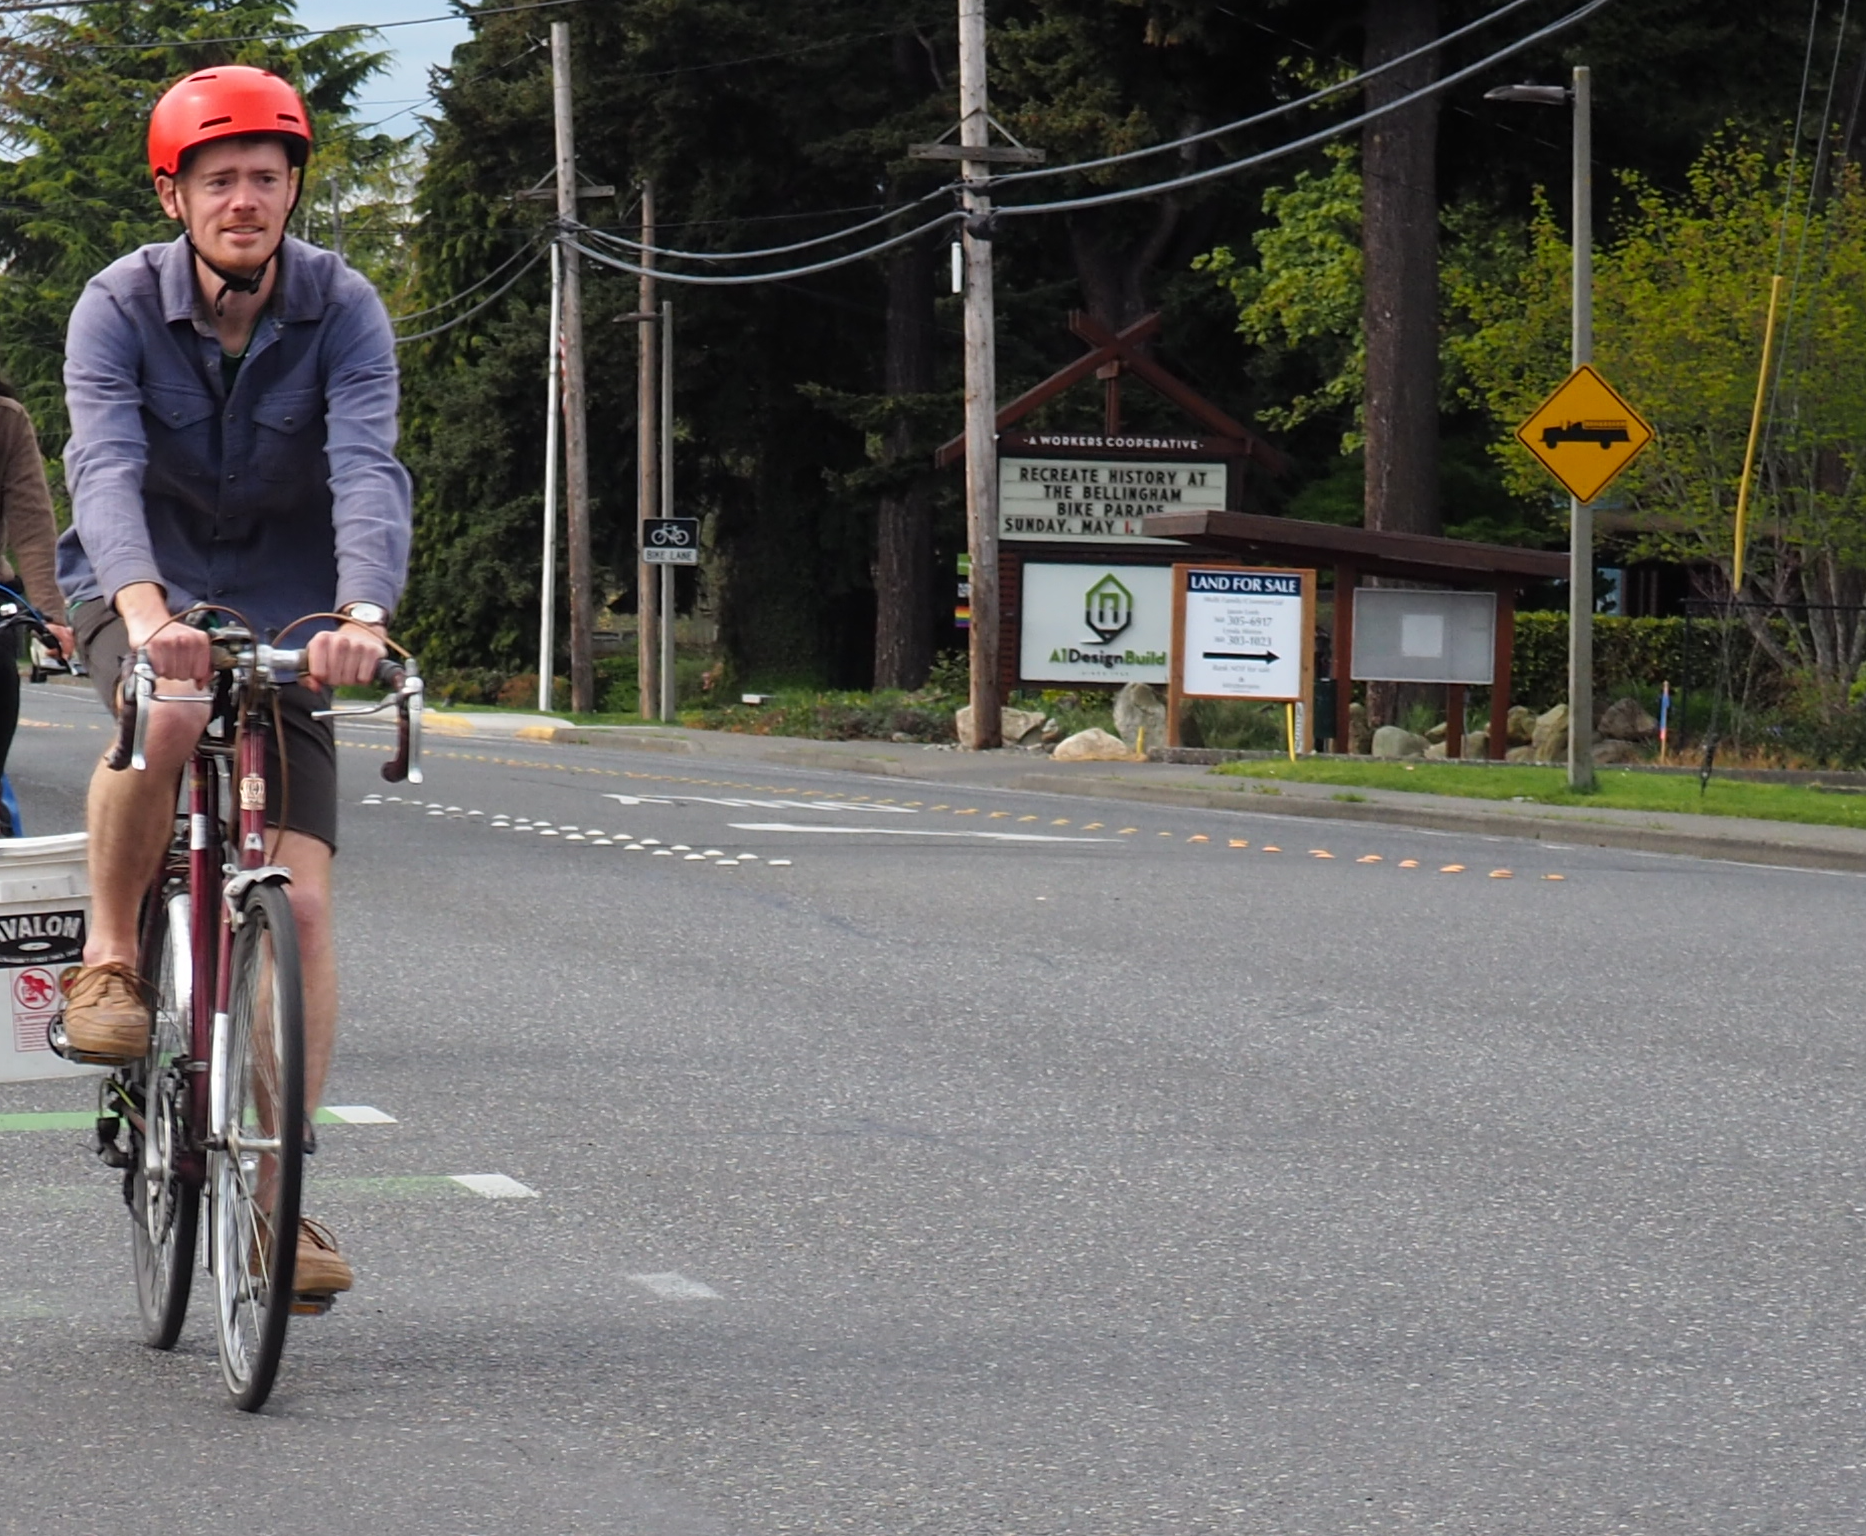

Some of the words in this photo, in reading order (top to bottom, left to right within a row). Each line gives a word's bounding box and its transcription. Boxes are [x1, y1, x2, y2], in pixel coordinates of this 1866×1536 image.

[1040, 436, 1103, 447] WORKERS
[1105, 437, 1199, 450] COOPERATIVE
[1019, 467, 1099, 483] RECREATE
[1108, 469, 1177, 485] HISTORY
[1187, 472, 1208, 487] AT
[1043, 485, 1073, 499] THE
[1083, 486, 1182, 502] BELLINGHAM
[1057, 502, 1094, 517] BIKE
[1081, 520, 1115, 534] MAY
[646, 550, 665, 560] BIKE
[670, 550, 693, 561] LANE
[1190, 575, 1230, 590] LAND
[1232, 577, 1262, 592] FOR
[1264, 578, 1298, 593] SALE
